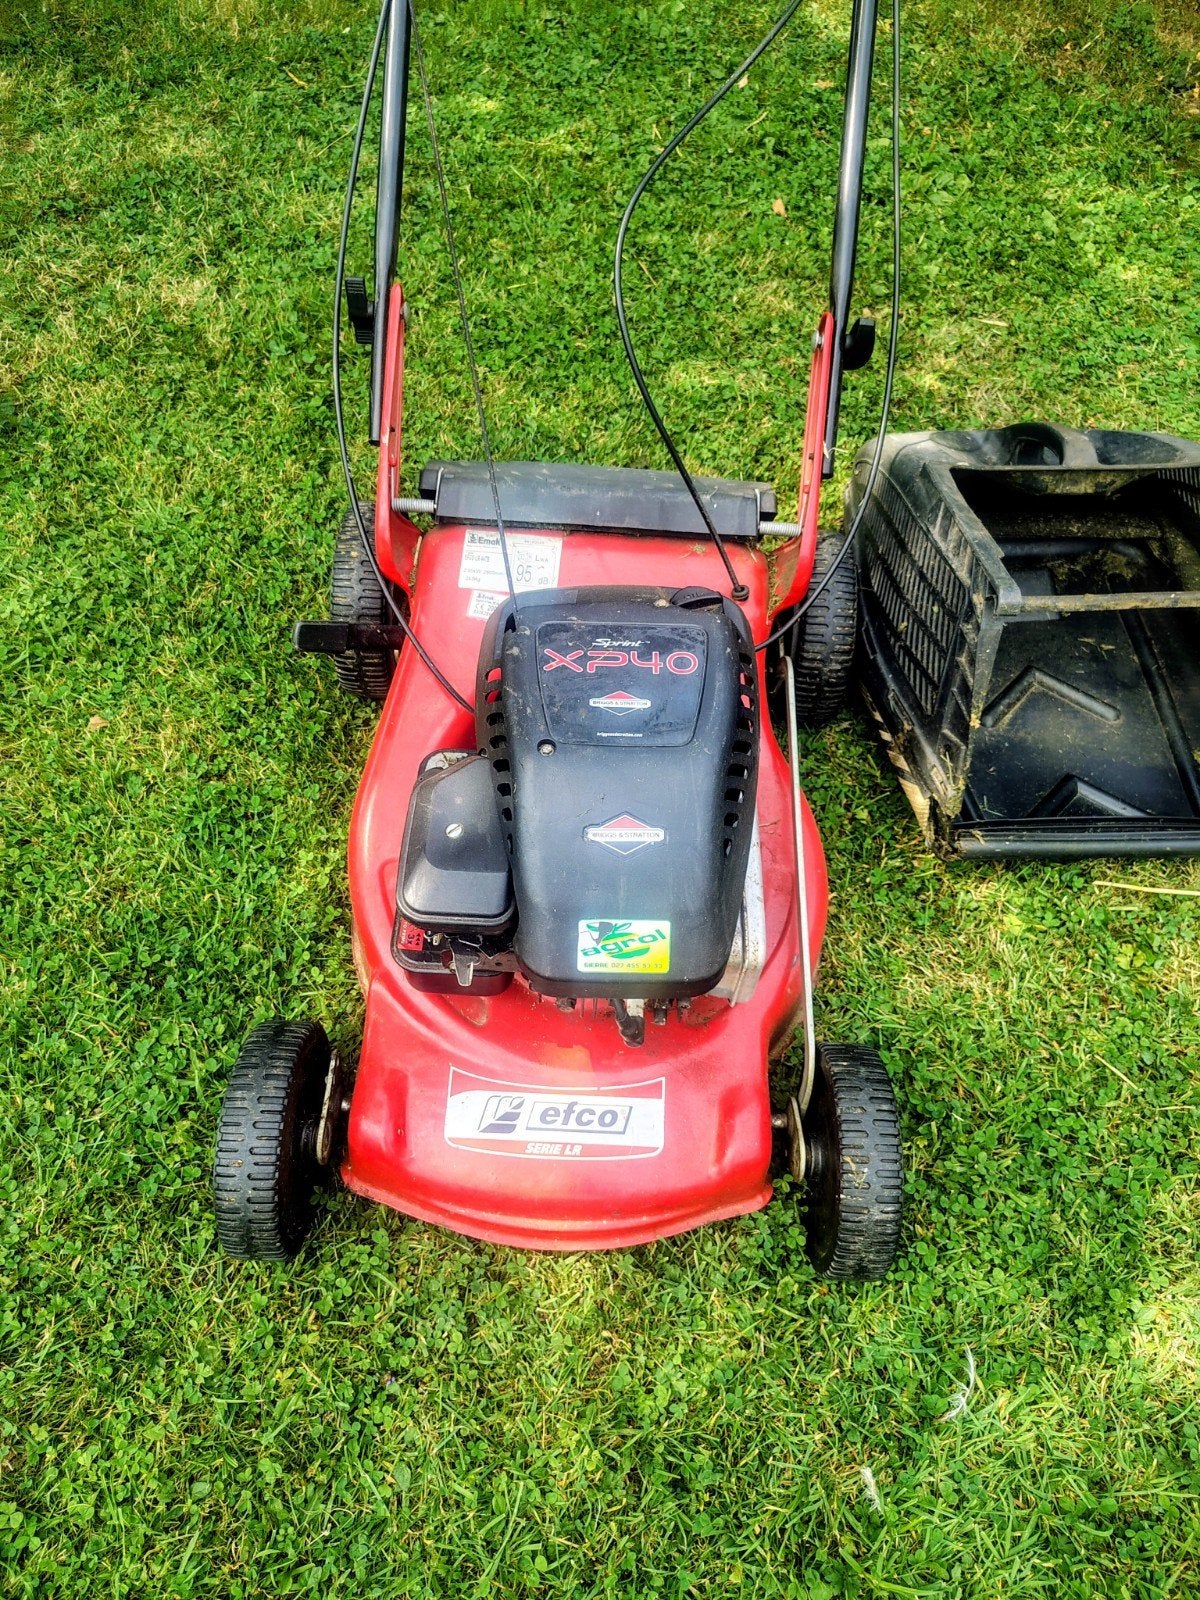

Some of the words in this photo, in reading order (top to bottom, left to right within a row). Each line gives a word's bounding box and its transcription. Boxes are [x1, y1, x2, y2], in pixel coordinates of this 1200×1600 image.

[516, 564, 532, 582] 95
[538, 576, 549, 585] dB
[592, 638, 646, 648] Sprint
[544, 649, 698, 675] XP40
[581, 929, 667, 957] agrol
[539, 1101, 619, 1128] efco
[525, 1142, 562, 1155] SERIE
[564, 1144, 582, 1156] LR
